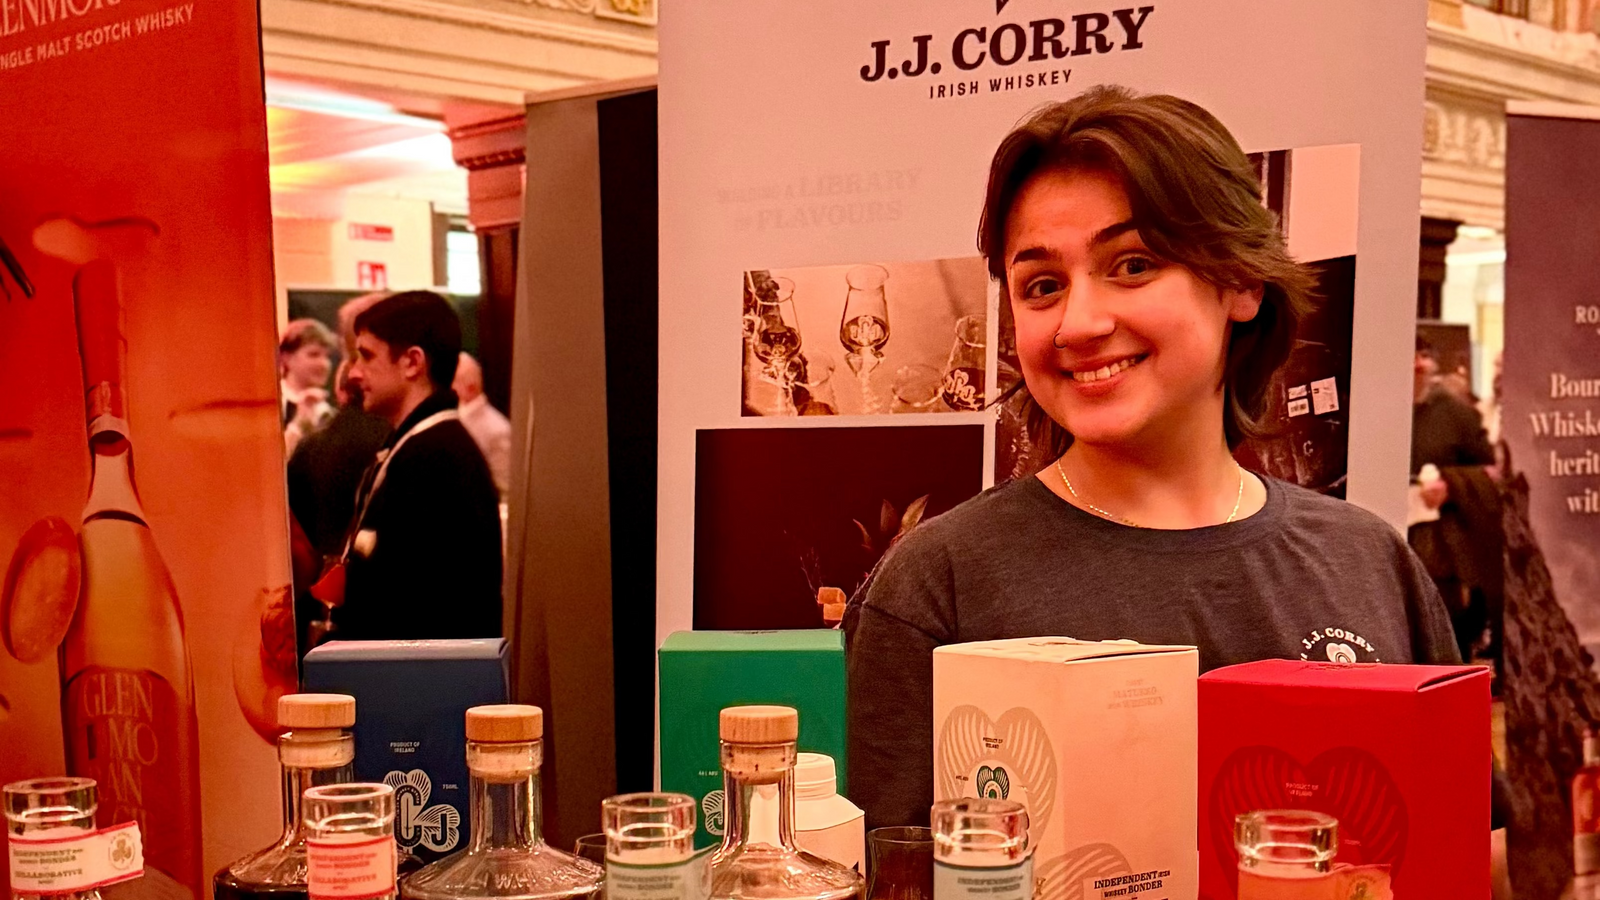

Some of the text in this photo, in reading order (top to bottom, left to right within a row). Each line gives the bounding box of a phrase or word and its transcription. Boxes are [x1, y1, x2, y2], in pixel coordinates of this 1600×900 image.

[37, 36, 71, 61] MALT
[75, 20, 131, 50] SCOTCH
[135, 3, 194, 36] WHISKY
[860, 5, 1154, 82] J.J. CORRY
[929, 69, 1072, 99] IRISH WHISKEY
[798, 167, 923, 197] LIBRARY
[756, 199, 904, 231] FLAVOURS
[1302, 627, 1375, 653] J.J. CORRY
[83, 672, 153, 722] GLEN
[108, 717, 159, 765] MO
[1094, 870, 1158, 889] INDEPENDENT
[1128, 880, 1163, 894] BONDER
